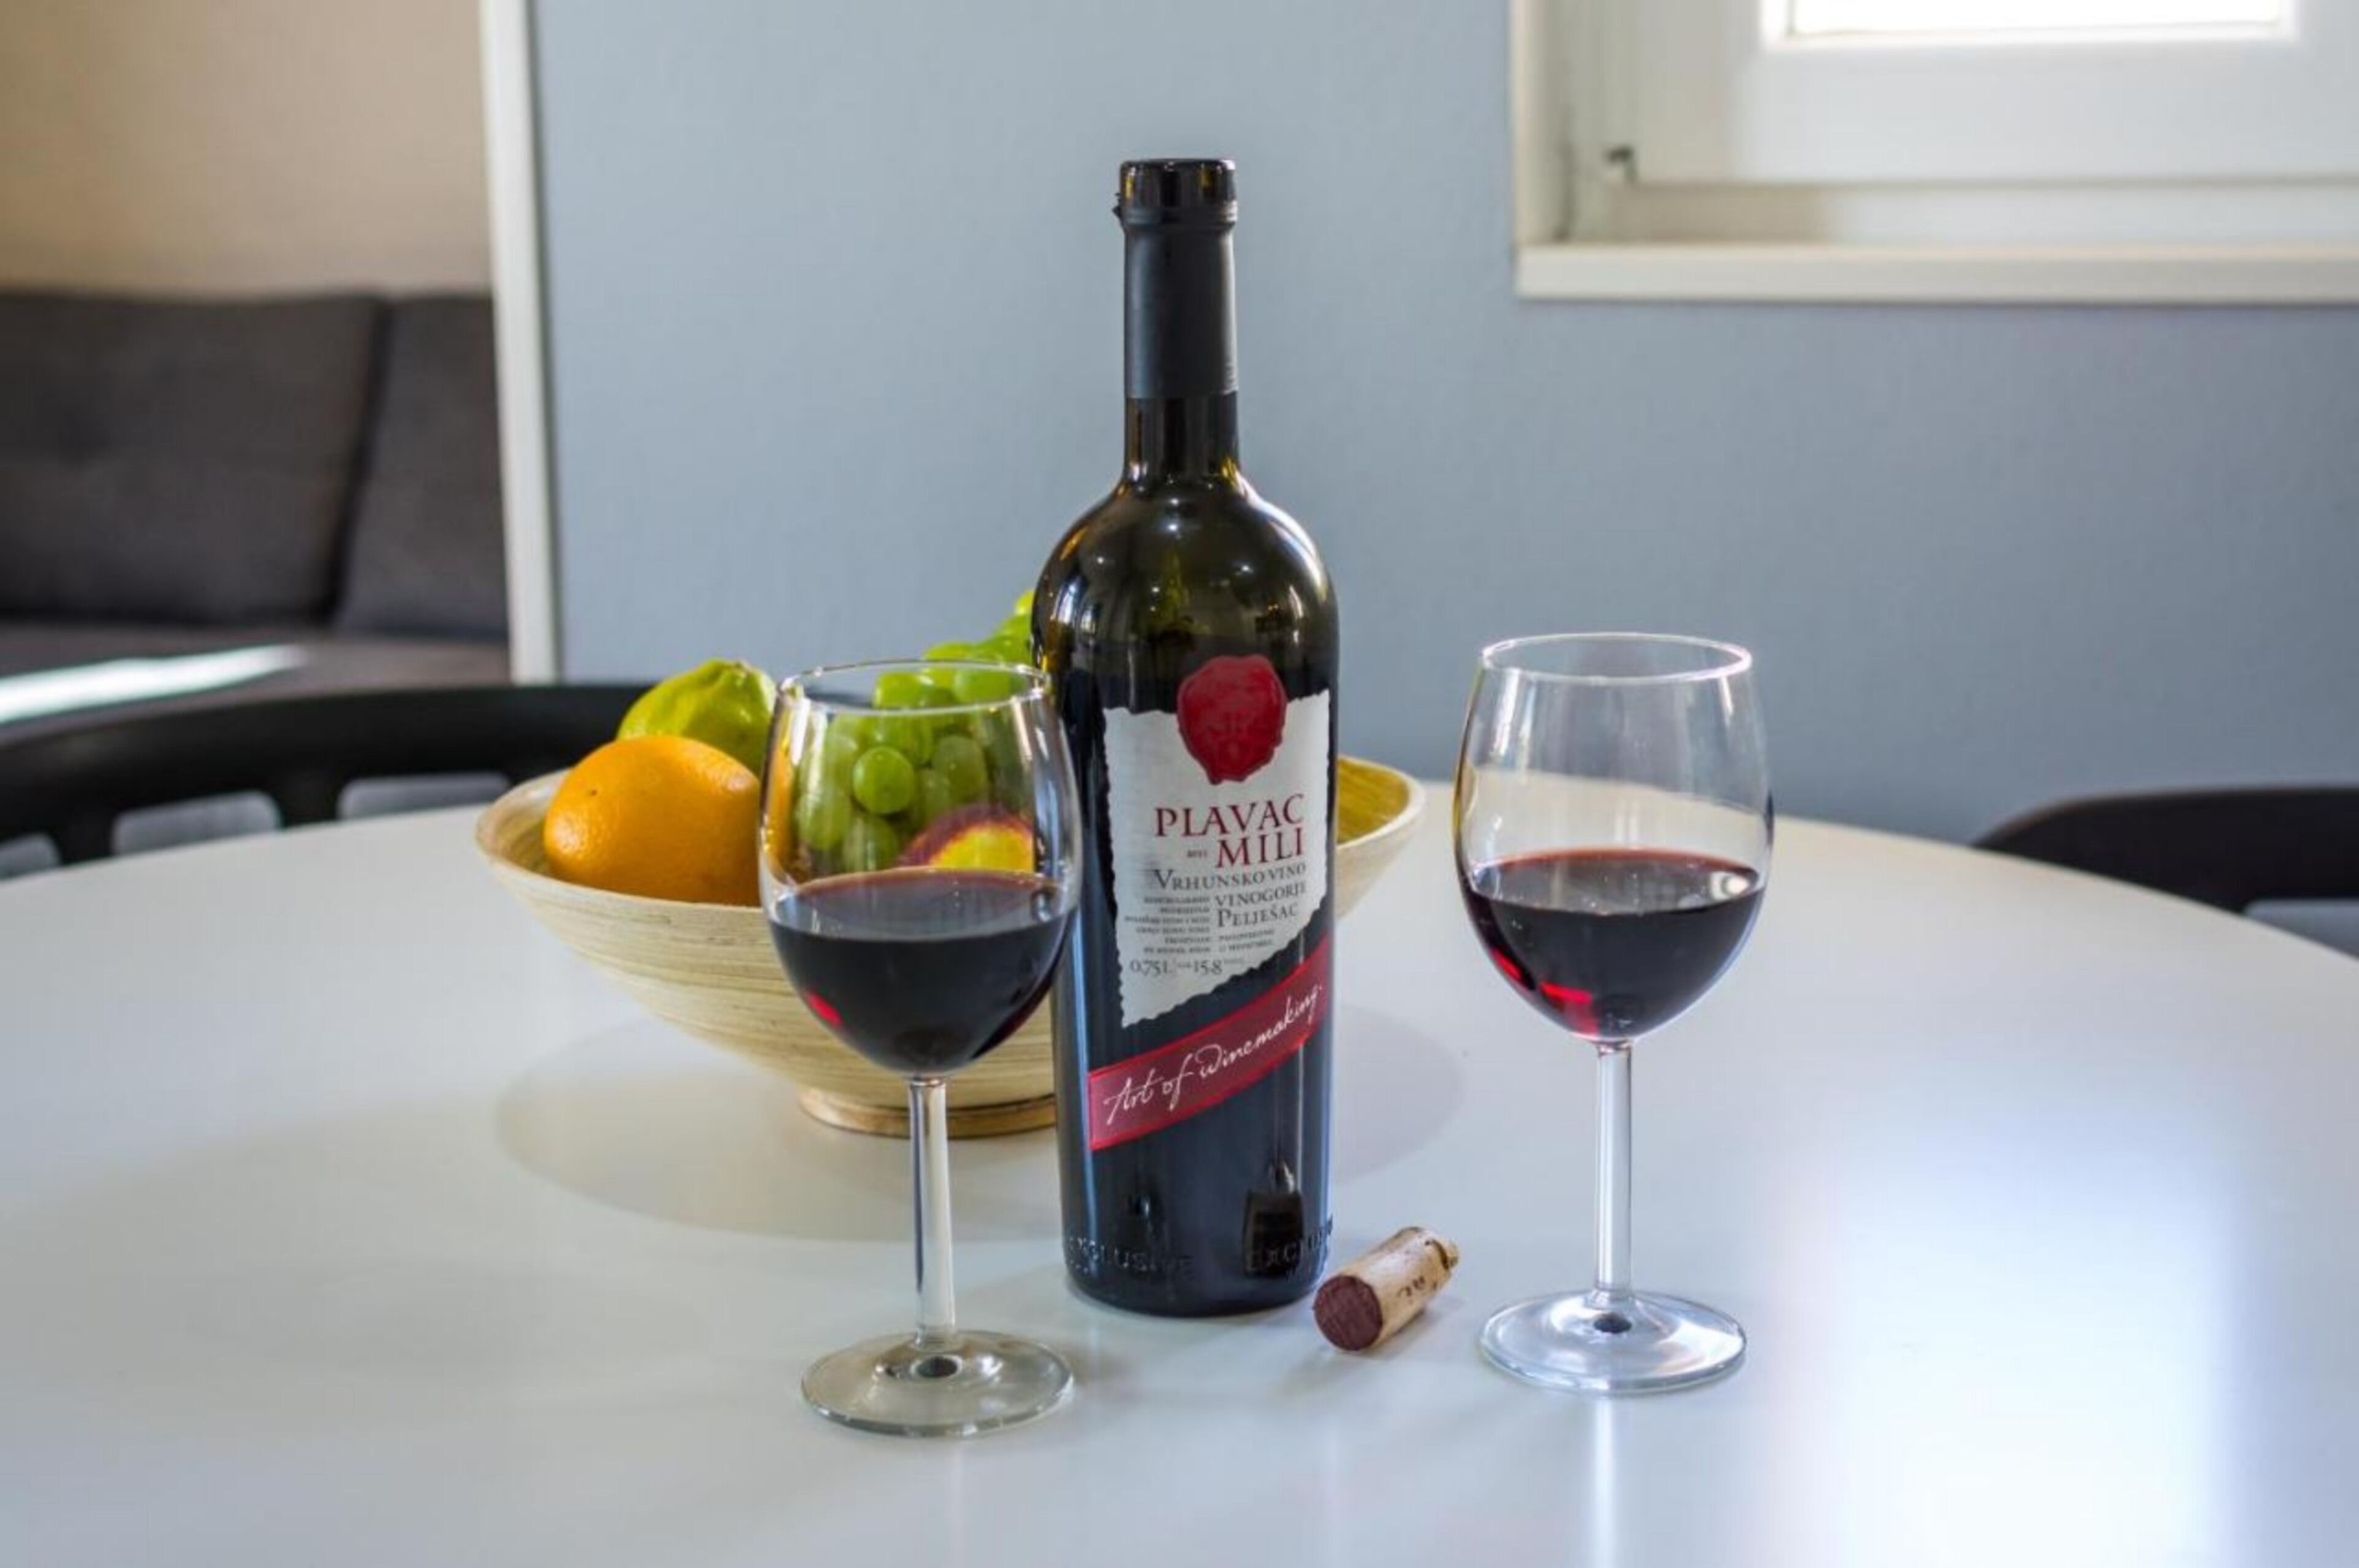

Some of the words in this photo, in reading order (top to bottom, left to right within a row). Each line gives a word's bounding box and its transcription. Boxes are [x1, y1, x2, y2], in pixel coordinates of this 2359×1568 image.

[1155, 793, 1304, 838] PLAVAC
[1216, 827, 1304, 868] MILI
[1154, 870, 1265, 891] VRHUNSKO
[1266, 862, 1307, 881] VINO
[1216, 881, 1306, 907] VINOGORJE
[1218, 902, 1298, 928] PELJEŠAC
[1103, 1067, 1163, 1126] Art
[1162, 1053, 1194, 1112] of
